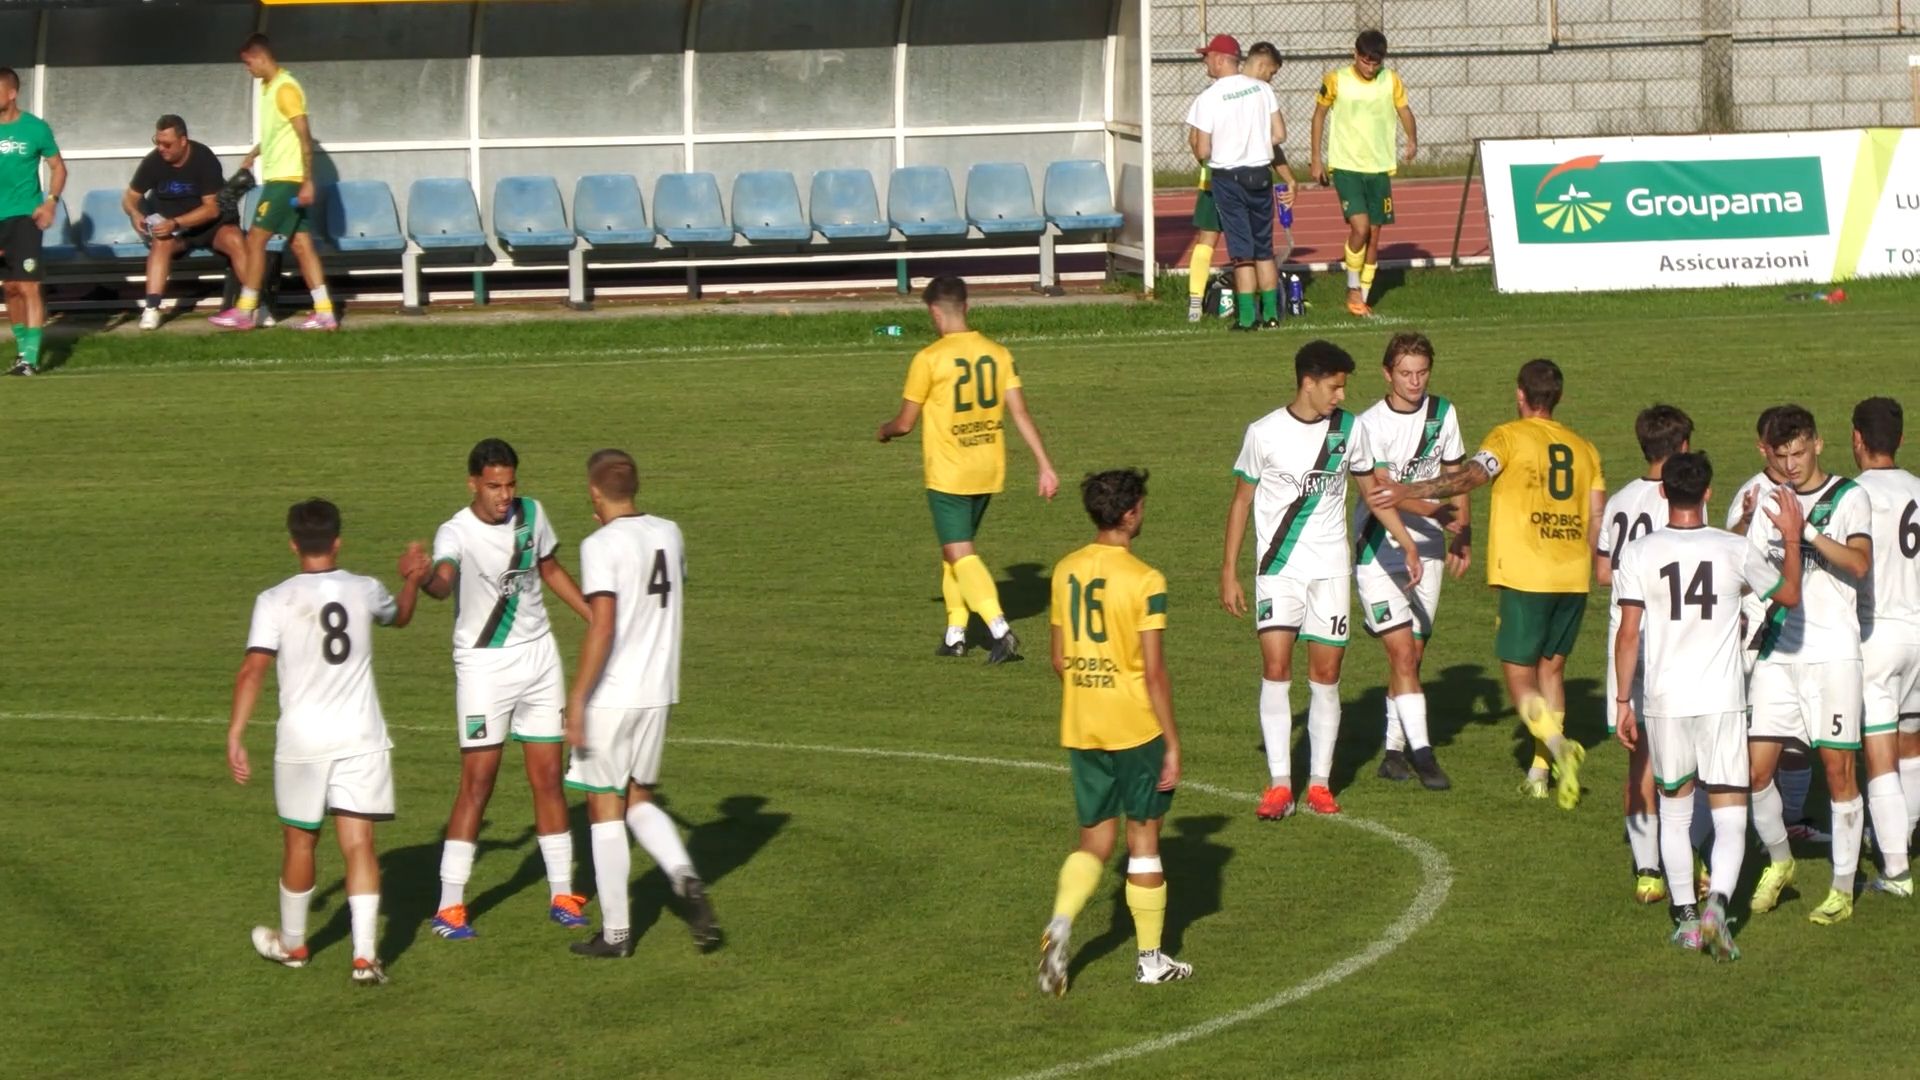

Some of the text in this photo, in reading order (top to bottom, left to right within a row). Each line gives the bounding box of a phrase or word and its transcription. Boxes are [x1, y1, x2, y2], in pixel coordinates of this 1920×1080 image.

[1626, 187, 1803, 222] Groupama
[1659, 250, 1810, 272] Assicurazioni
[1885, 248, 1897, 263] T
[954, 355, 998, 413] 20
[1548, 443, 1574, 501] 8
[1898, 498, 1920, 560] 6
[647, 548, 671, 609] 4
[1659, 560, 1718, 621] 14
[320, 601, 351, 665] 8
[1068, 573, 1108, 644] 16
[1330, 615, 1347, 636] 16
[1831, 713, 1843, 737] 5
